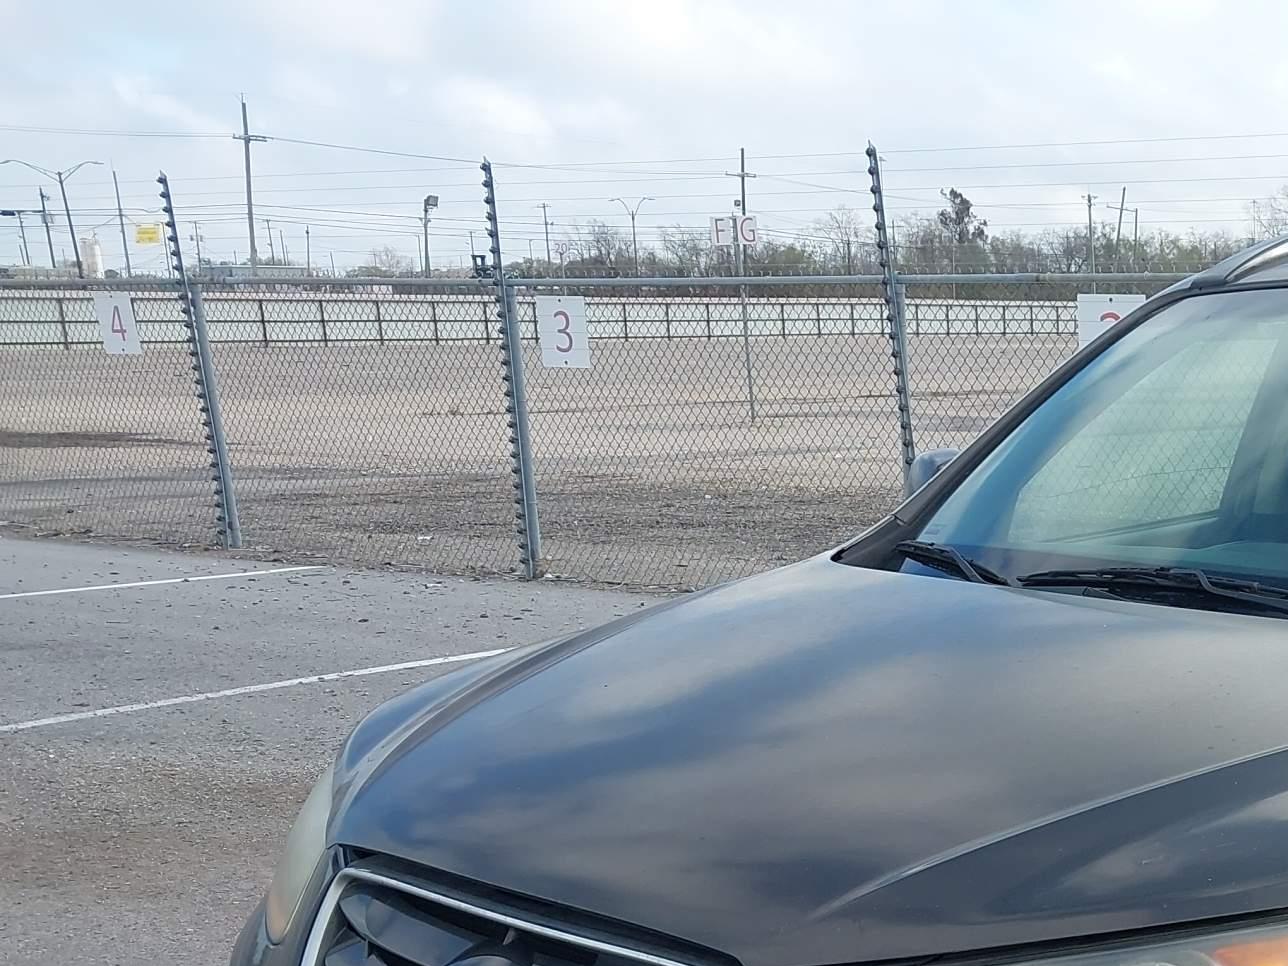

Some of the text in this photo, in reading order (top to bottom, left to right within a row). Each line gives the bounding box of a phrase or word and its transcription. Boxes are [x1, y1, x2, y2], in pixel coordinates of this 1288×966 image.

[715, 218, 725, 243] F
[740, 217, 756, 243] G
[111, 305, 127, 341] 4
[553, 310, 573, 353] 3
